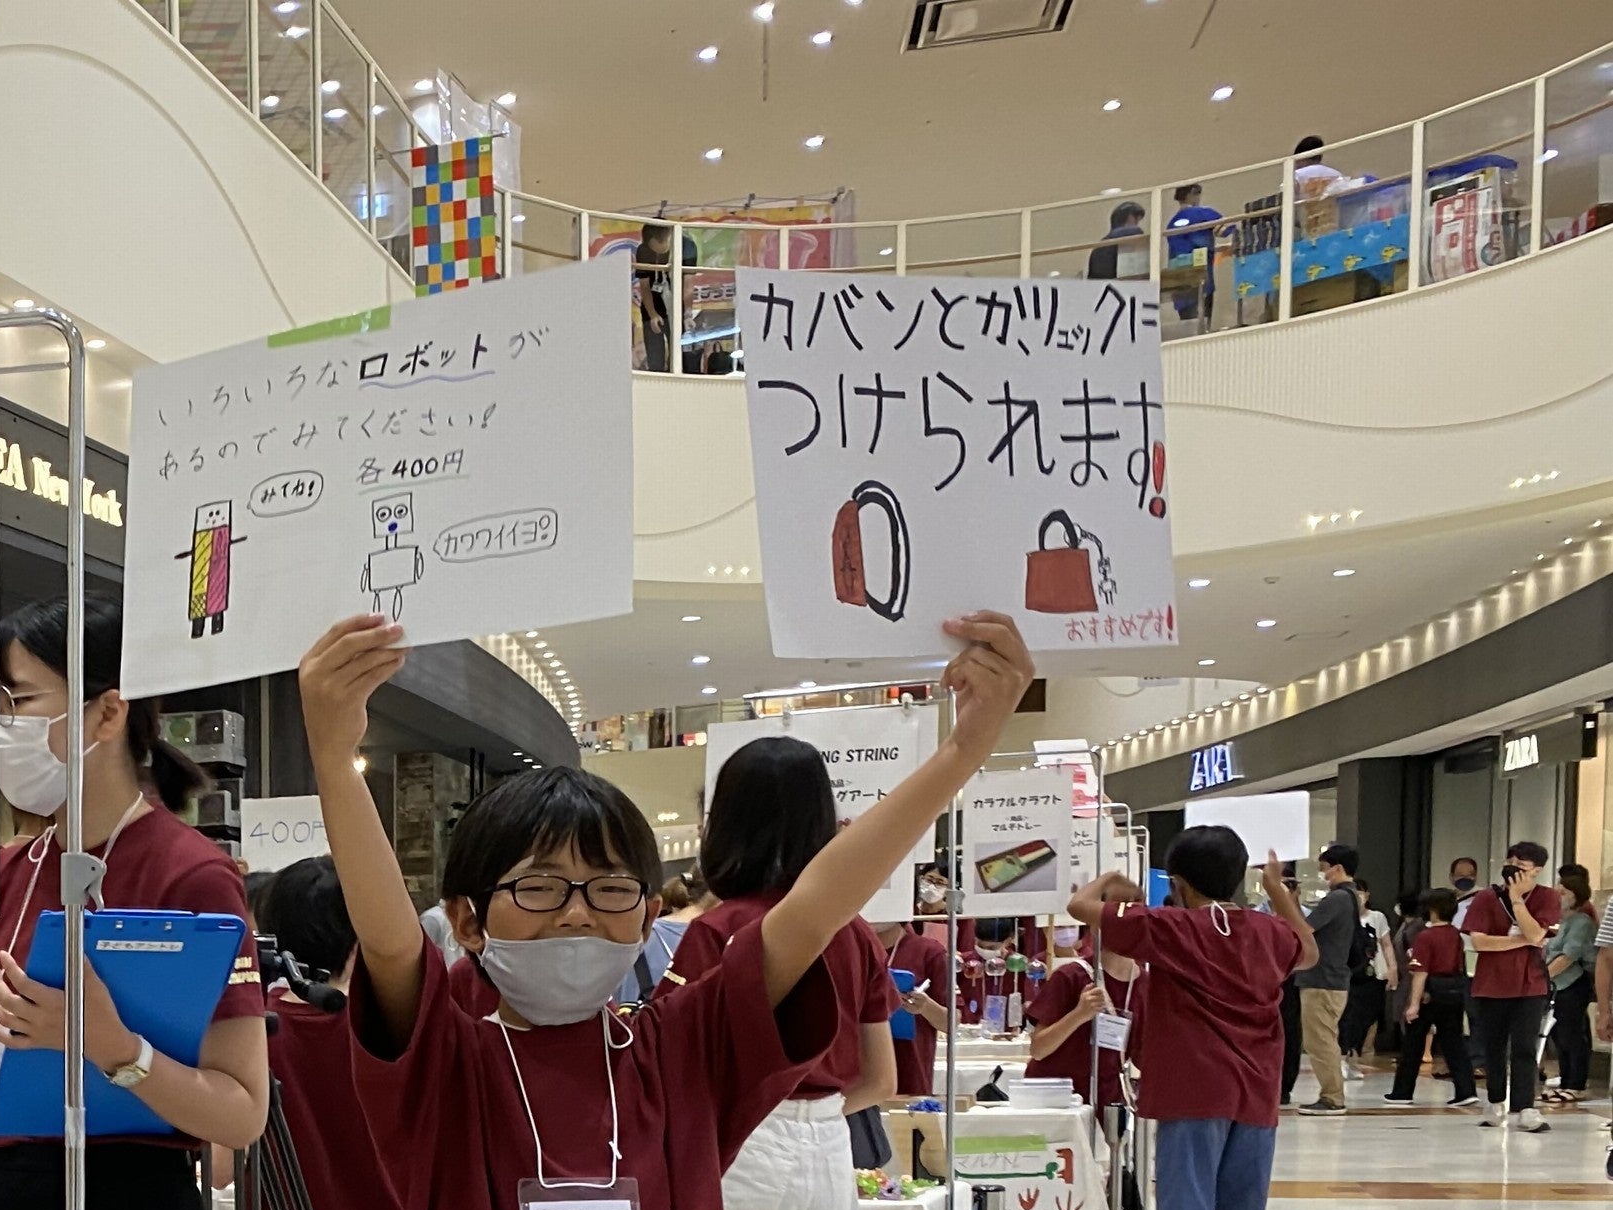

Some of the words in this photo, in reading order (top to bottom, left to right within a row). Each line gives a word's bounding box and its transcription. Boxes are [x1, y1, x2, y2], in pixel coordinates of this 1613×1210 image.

[158, 327, 551, 428] いろいろなロボットが
[159, 403, 497, 481] あるのでみてください!
[355, 449, 464, 485] 各400円
[822, 749, 840, 764] NG
[845, 746, 900, 763] STRING
[1504, 734, 1539, 771] ZARA
[835, 788, 888, 802] グアート
[972, 794, 1063, 809] カラフルクラフト
[991, 821, 1043, 832] マルチトレー
